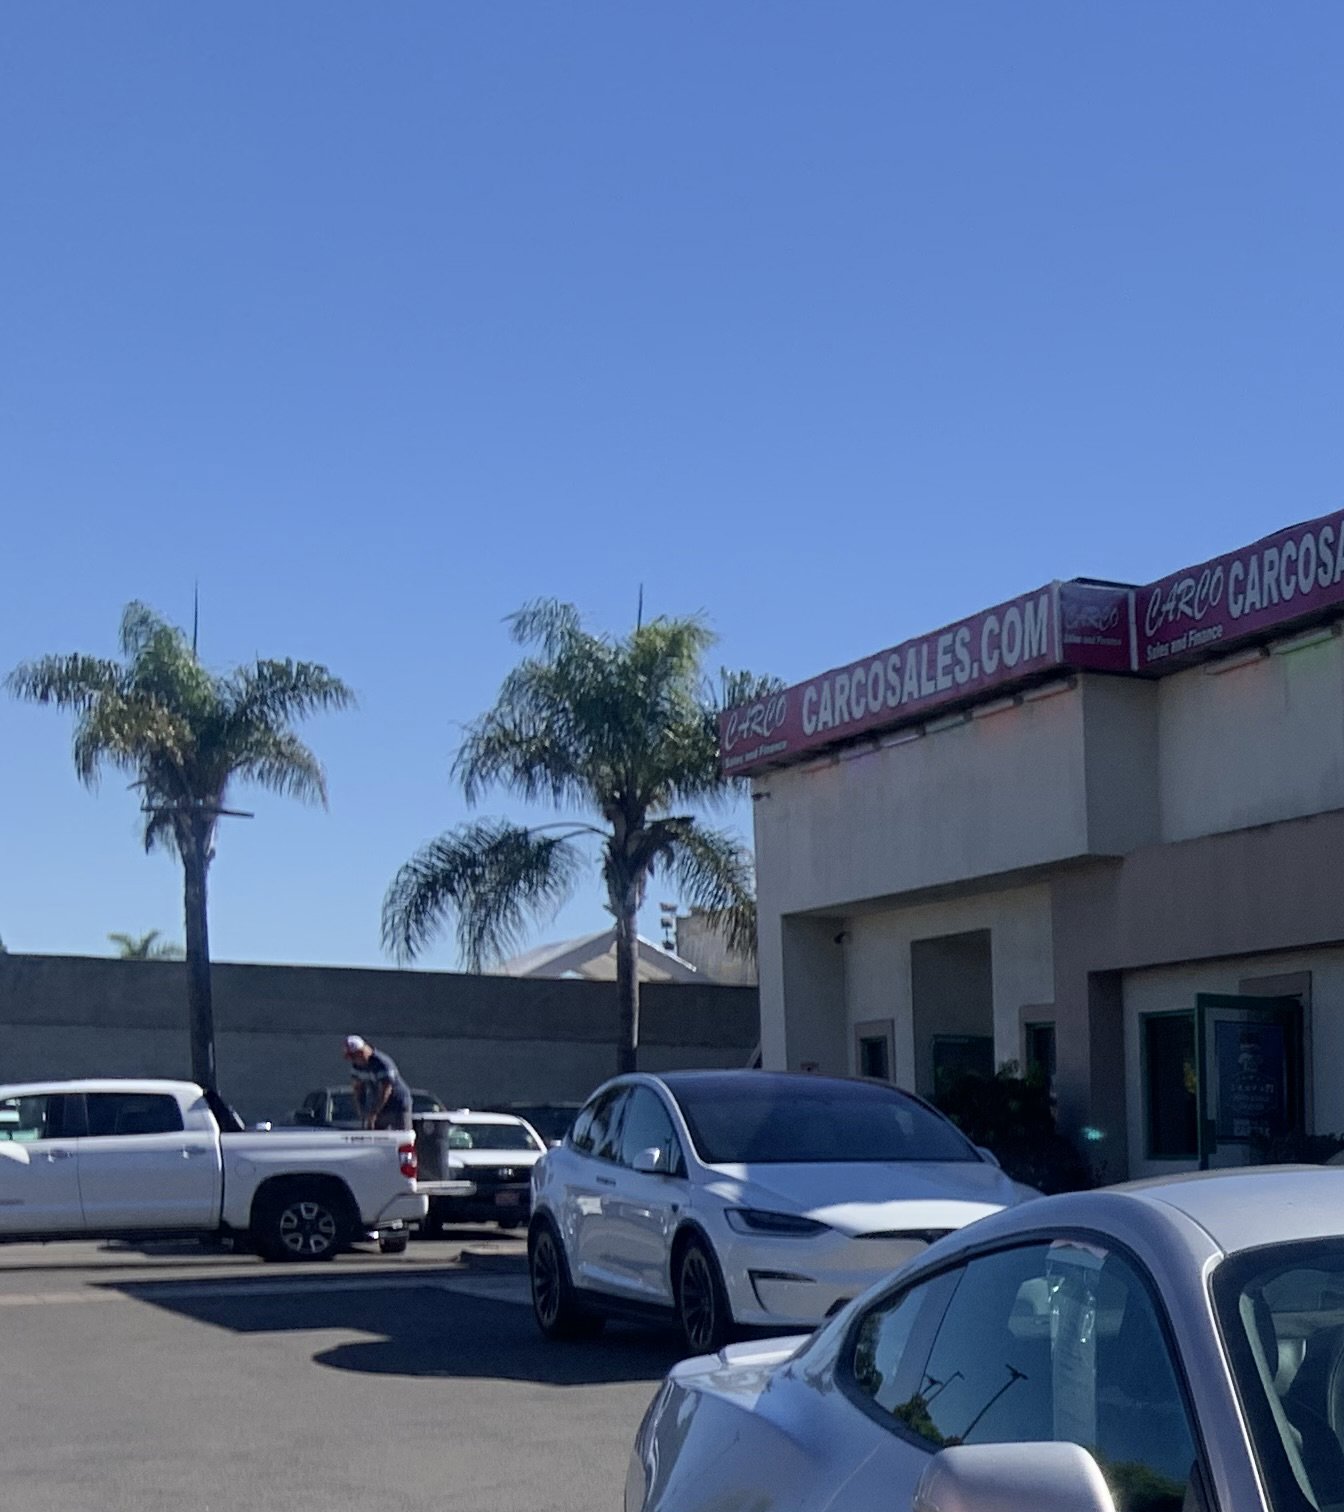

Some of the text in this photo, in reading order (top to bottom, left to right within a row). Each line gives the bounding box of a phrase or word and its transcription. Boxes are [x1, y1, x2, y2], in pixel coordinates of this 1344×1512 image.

[1145, 566, 1224, 637] CARCO
[802, 593, 1049, 736] CARCOSALES.COM
[1146, 624, 1223, 661] Sales and Finance
[724, 694, 786, 751] CARCO
